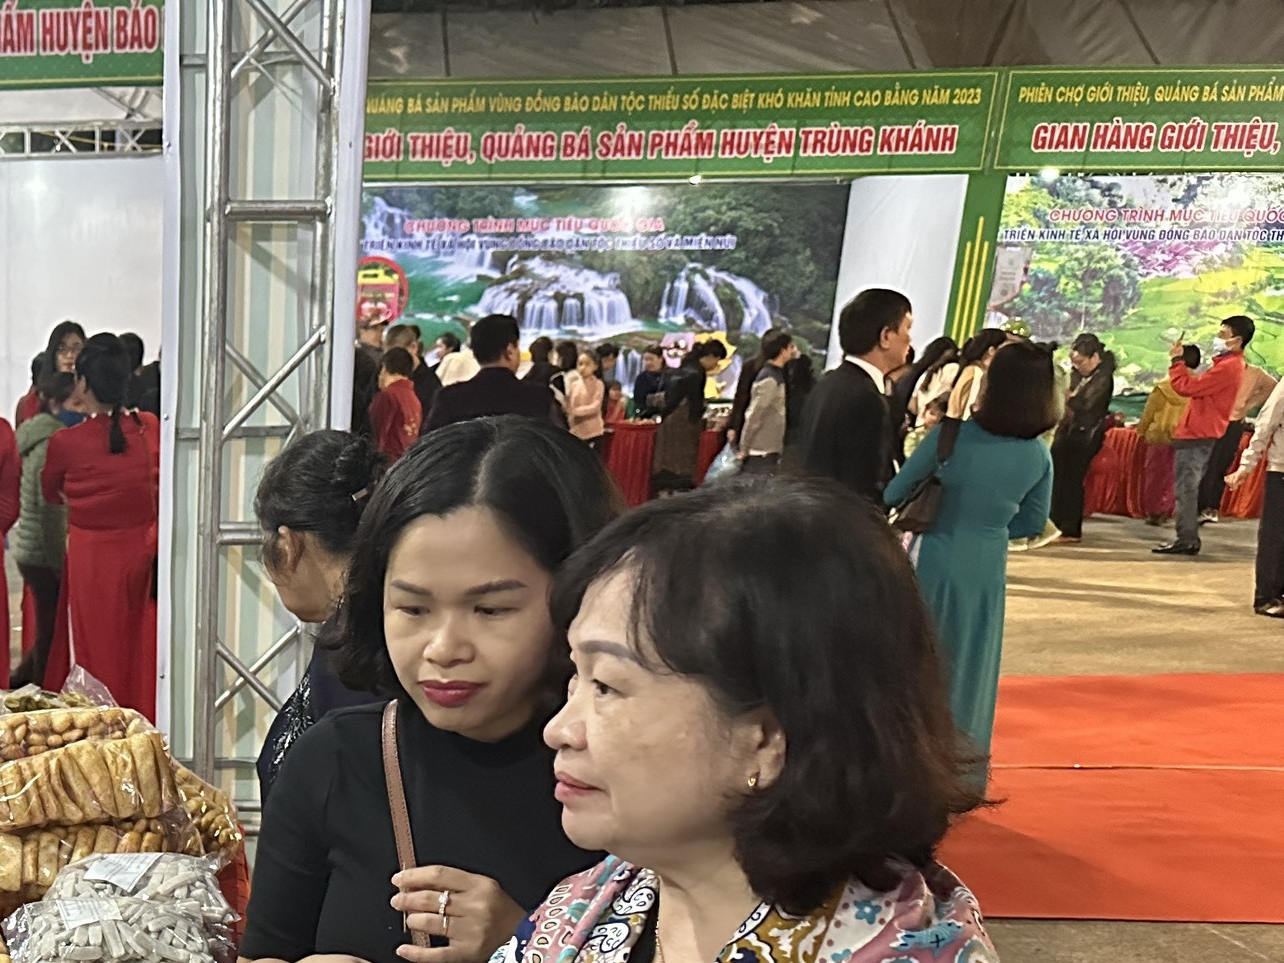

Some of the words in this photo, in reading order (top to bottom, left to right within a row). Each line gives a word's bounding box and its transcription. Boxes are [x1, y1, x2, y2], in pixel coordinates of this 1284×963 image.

[39, 1, 110, 63] HUYỆN
[366, 92, 404, 114] UẢNG
[407, 92, 423, 114] BÁ
[425, 91, 449, 114] SẢN
[452, 88, 486, 113] PHẨM
[489, 92, 522, 113] VÙNG
[525, 88, 561, 112] ĐỒNG
[592, 91, 617, 112] DÂN
[621, 91, 645, 116] TỘC
[648, 86, 680, 111] THIỂU
[683, 87, 701, 110] SỐ
[702, 89, 729, 114] ĐẶC
[731, 88, 756, 114] BIỆT
[757, 87, 784, 109] KHÓ
[787, 89, 822, 109] KHĂN
[823, 86, 851, 107] TỈNH
[853, 90, 881, 107] CAO
[884, 81, 919, 107] BẰNG
[922, 85, 950, 105] NĂM
[953, 88, 982, 105] 2023
[1019, 82, 1055, 104] PHIÊN
[1056, 83, 1084, 107] CHỢ
[1087, 81, 1114, 102] GIỚI
[1116, 81, 1152, 107] THIỆU,
[1154, 80, 1199, 103] QUẢNG
[1202, 82, 1218, 102] BÁ
[1221, 79, 1246, 102] SẢN
[364, 127, 403, 162] GIỚI
[407, 127, 476, 166] THIỆU,
[481, 124, 558, 165] QUẢNG
[560, 126, 592, 161] BÁ
[596, 122, 644, 160] SẢN
[648, 119, 716, 159] PHẨM
[719, 122, 796, 162] HUYỆN
[878, 120, 959, 155] KHÁNH
[1032, 123, 1088, 152] GIAN
[1090, 117, 1155, 151] HÀNG
[1159, 117, 1207, 152] GIỚI
[1211, 117, 1281, 158] THIỆU,
[1121, 206, 1165, 222] TRÌNH
[1038, 228, 1066, 241] KINH
